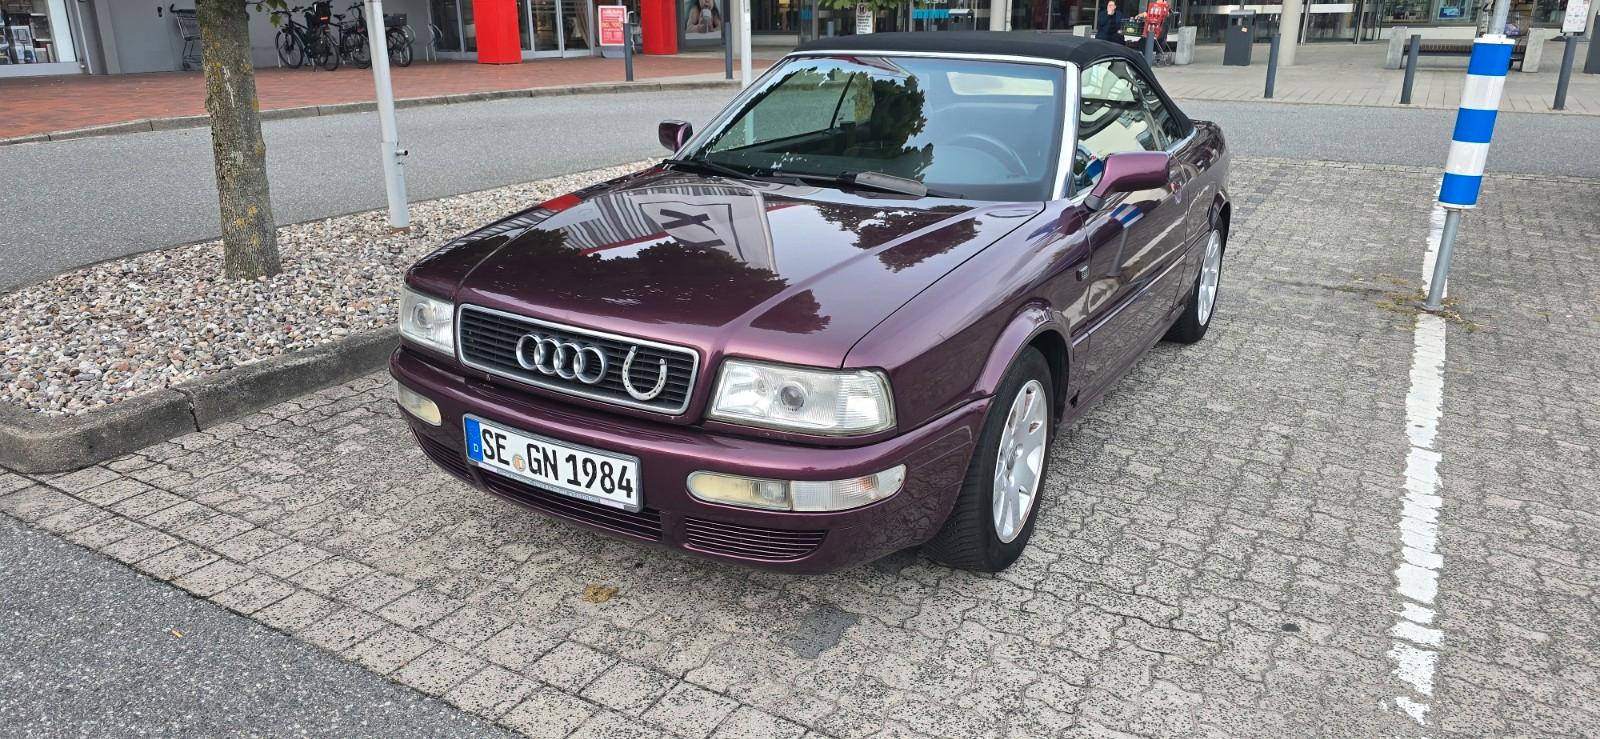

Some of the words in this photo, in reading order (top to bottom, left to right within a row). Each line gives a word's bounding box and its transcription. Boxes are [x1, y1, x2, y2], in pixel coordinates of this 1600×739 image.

[474, 443, 479, 453] D
[482, 428, 509, 466] SE
[526, 443, 559, 481] GN
[565, 454, 633, 499] 1984
